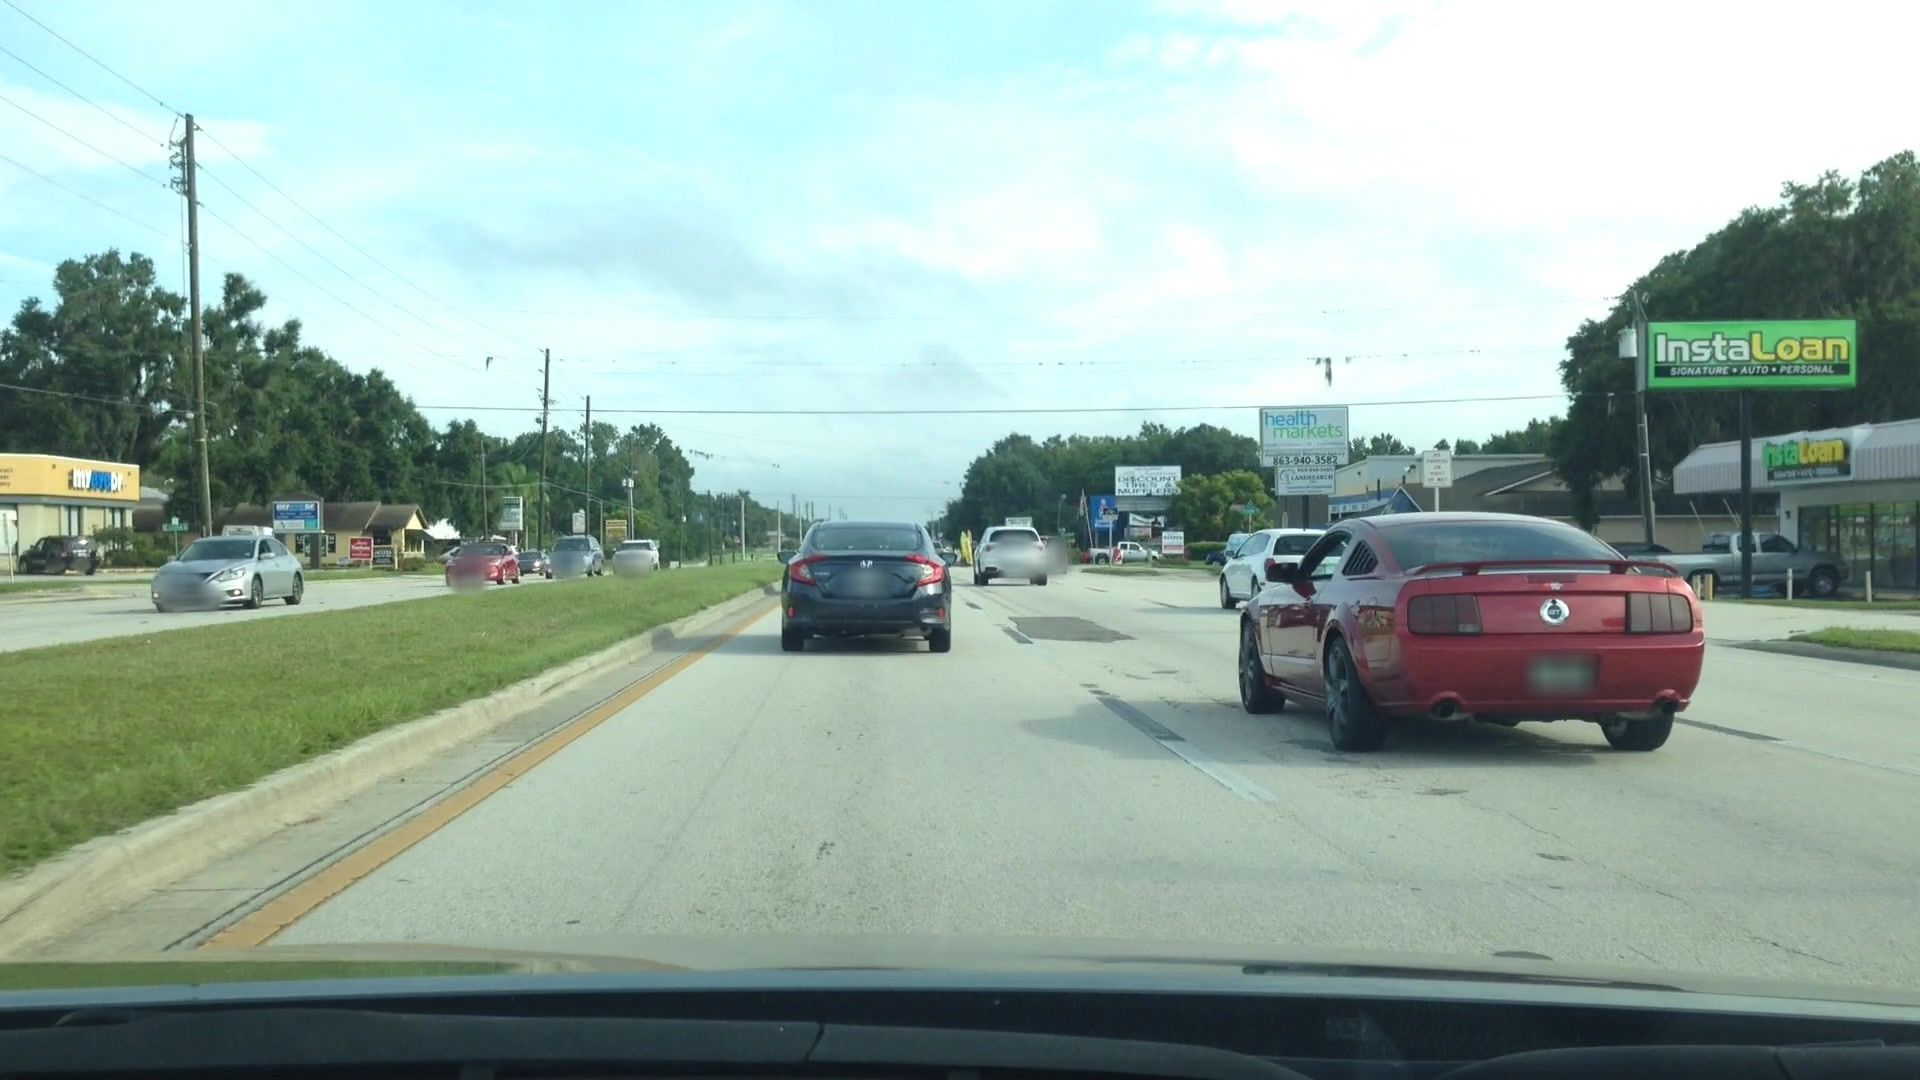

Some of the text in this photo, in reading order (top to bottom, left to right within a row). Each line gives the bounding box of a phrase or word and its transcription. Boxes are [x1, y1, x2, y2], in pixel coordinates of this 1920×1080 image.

[1655, 331, 1850, 363] InstaLoan
[1670, 365, 1835, 376] SIGNATURE AUTO PERSONAL
[1265, 410, 1317, 426] health
[1273, 423, 1343, 440] markets
[1272, 455, 1338, 465] 863-940-3582
[1117, 475, 1177, 483] DISCOUNT
